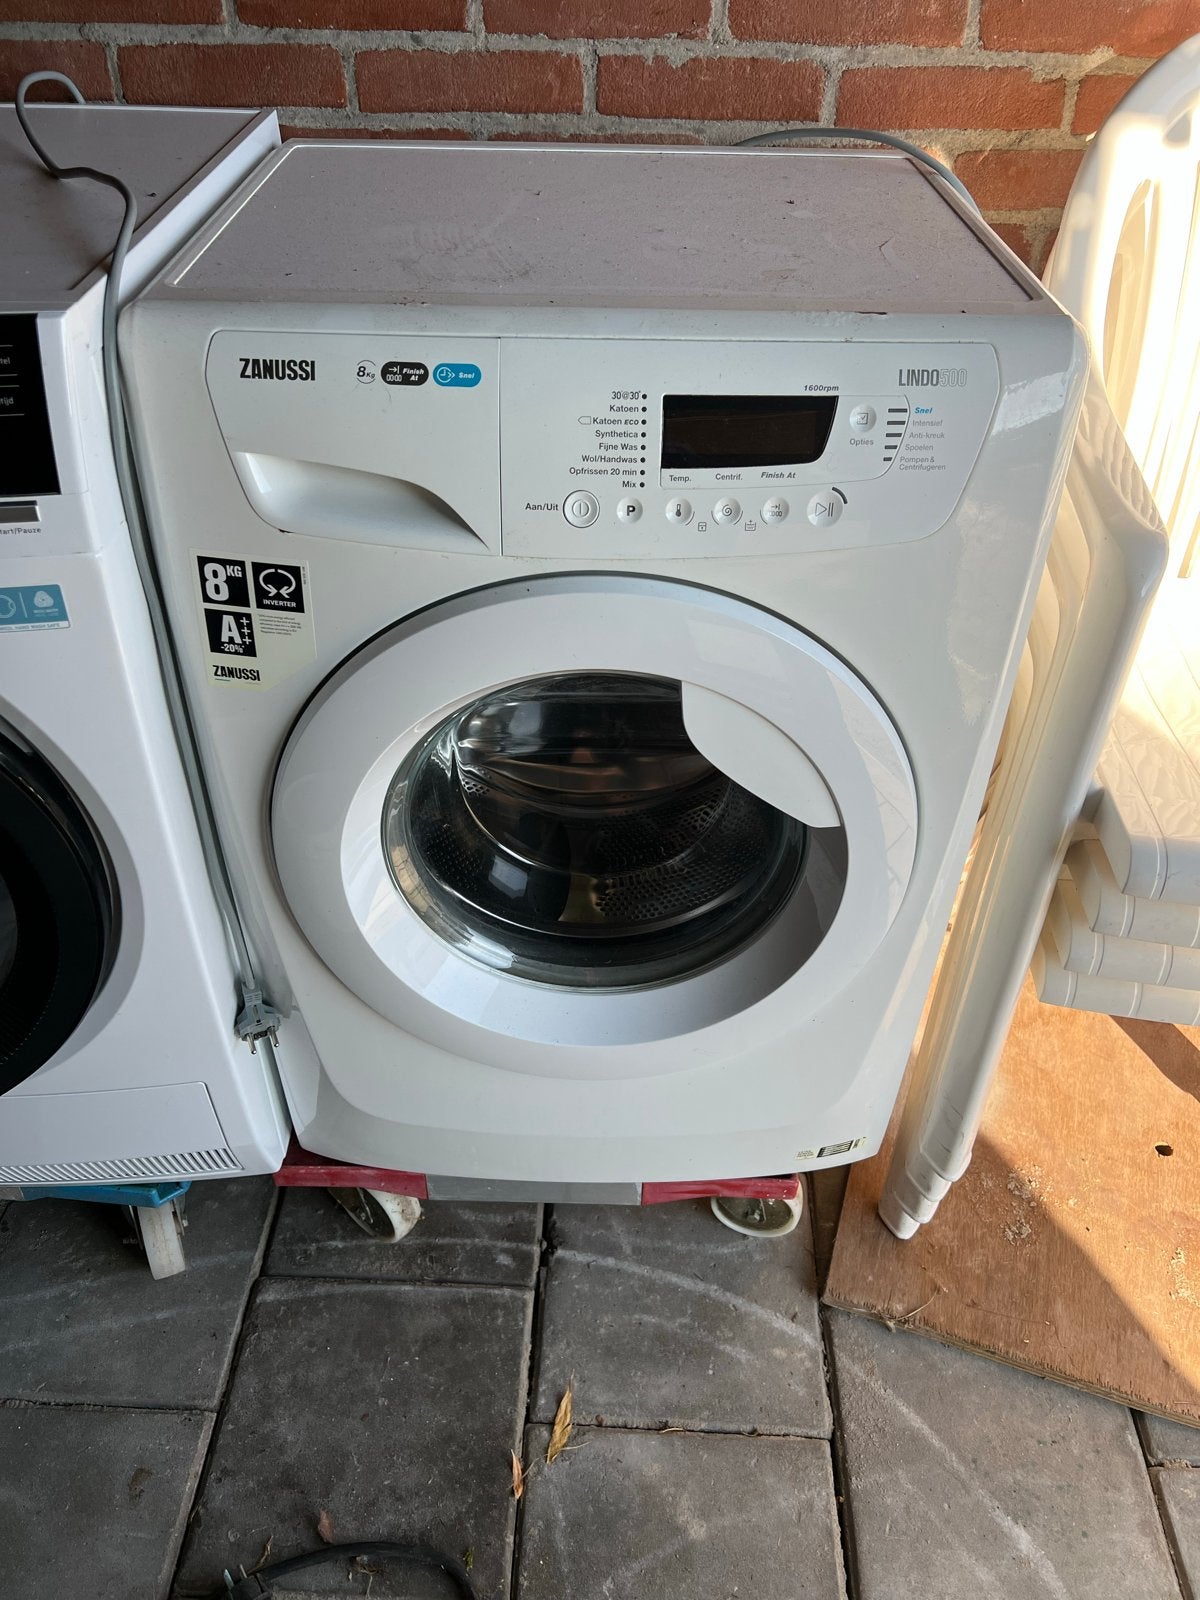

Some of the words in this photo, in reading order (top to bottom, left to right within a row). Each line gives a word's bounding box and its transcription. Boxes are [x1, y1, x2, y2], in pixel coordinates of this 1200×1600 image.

[239, 357, 316, 381] ZANUSSI
[403, 367, 425, 375] Finish
[458, 371, 475, 379] Snel
[803, 384, 840, 393] 1600rpm
[609, 404, 639, 413] Katoen
[592, 416, 622, 425] Katoen
[912, 419, 943, 427] Intensief
[595, 429, 639, 439] Synthetica
[908, 431, 945, 440] Anti-kreuk
[849, 437, 874, 447] Opties
[598, 442, 619, 452] Fijne
[620, 443, 638, 451] Was
[904, 443, 934, 453] Spoelen
[581, 454, 638, 464] Wol/Handwas
[899, 456, 929, 465] Pompen
[569, 466, 609, 476] Opfrissen
[610, 467, 621, 476] 20
[622, 468, 637, 476] min
[898, 463, 946, 472] Centrifugeren
[669, 475, 692, 483] Temp.
[715, 472, 743, 481] Centrif.
[760, 471, 784, 479] Finish
[786, 471, 796, 479] At
[622, 480, 637, 488] Mix
[525, 502, 559, 512] Aan/Uit
[626, 505, 636, 517] P
[262, 598, 297, 608] INVERTER
[212, 664, 262, 682] ZANUSSI
